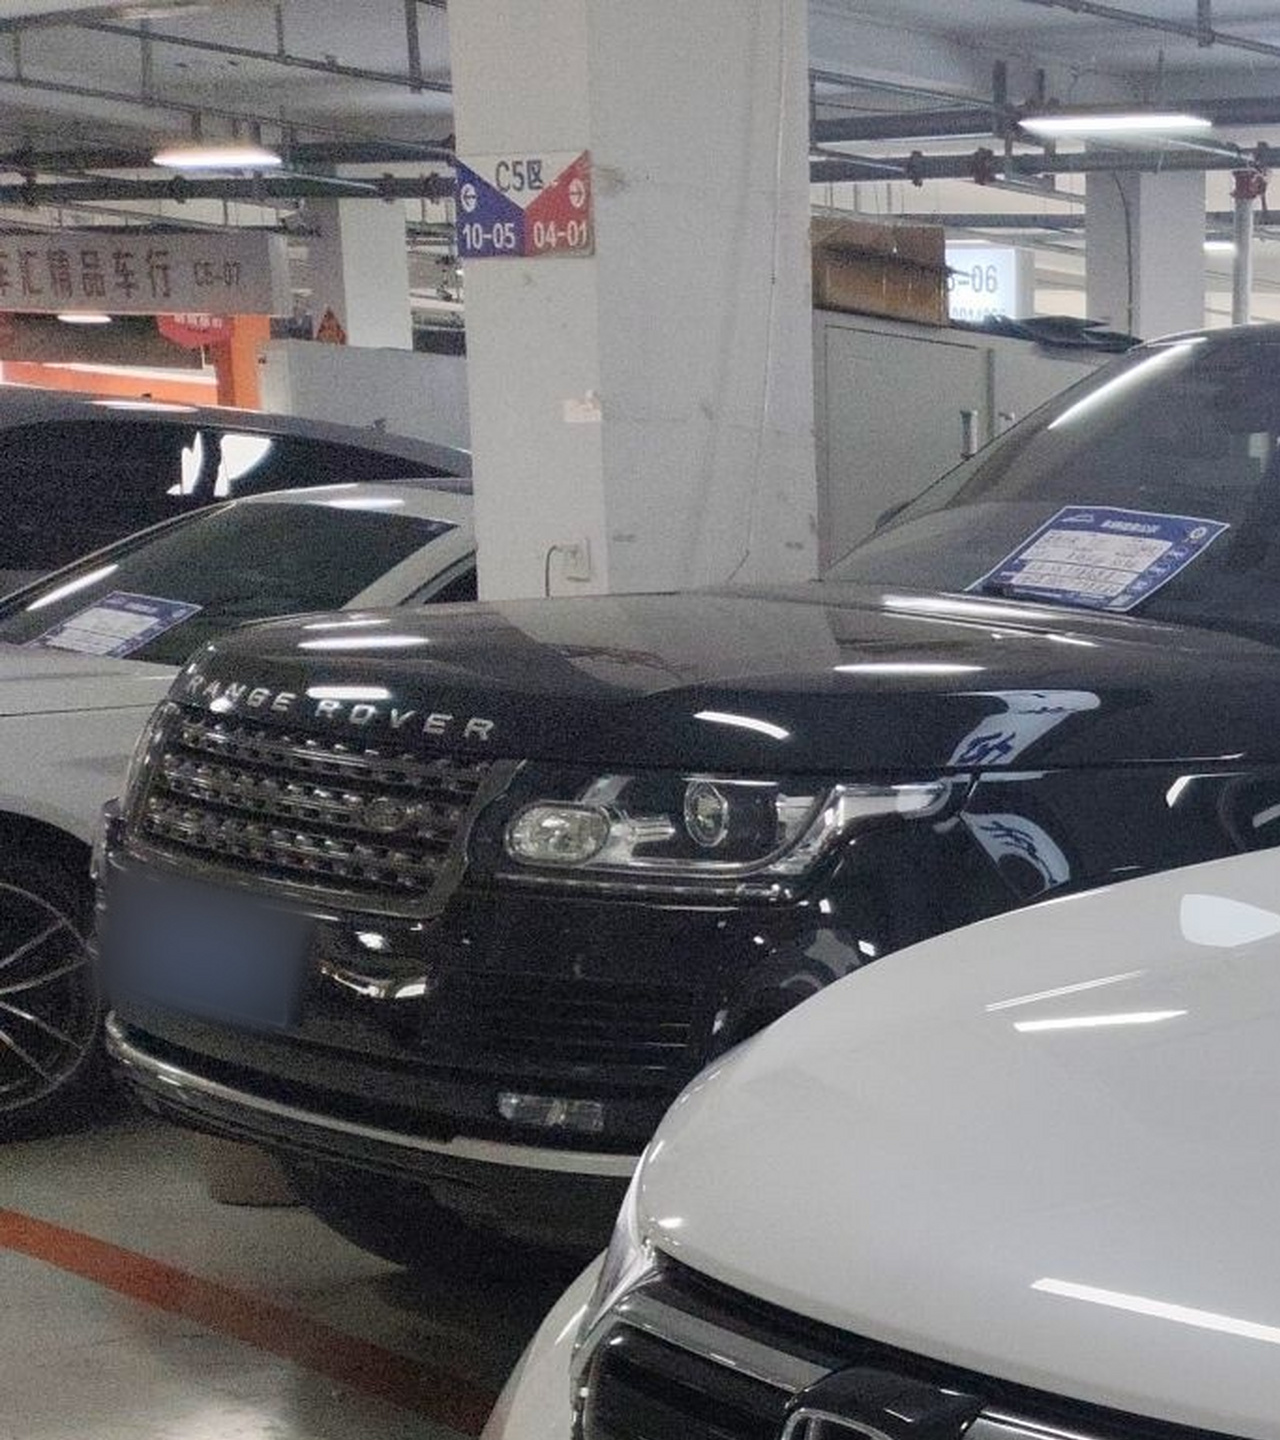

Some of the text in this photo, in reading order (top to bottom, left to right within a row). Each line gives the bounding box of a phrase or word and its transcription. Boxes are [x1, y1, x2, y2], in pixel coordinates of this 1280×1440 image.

[495, 160, 544, 192] C5区
[462, 222, 516, 249] 10-05
[533, 220, 588, 248] 04-01
[185, 673, 495, 740] RANGE ROVER
